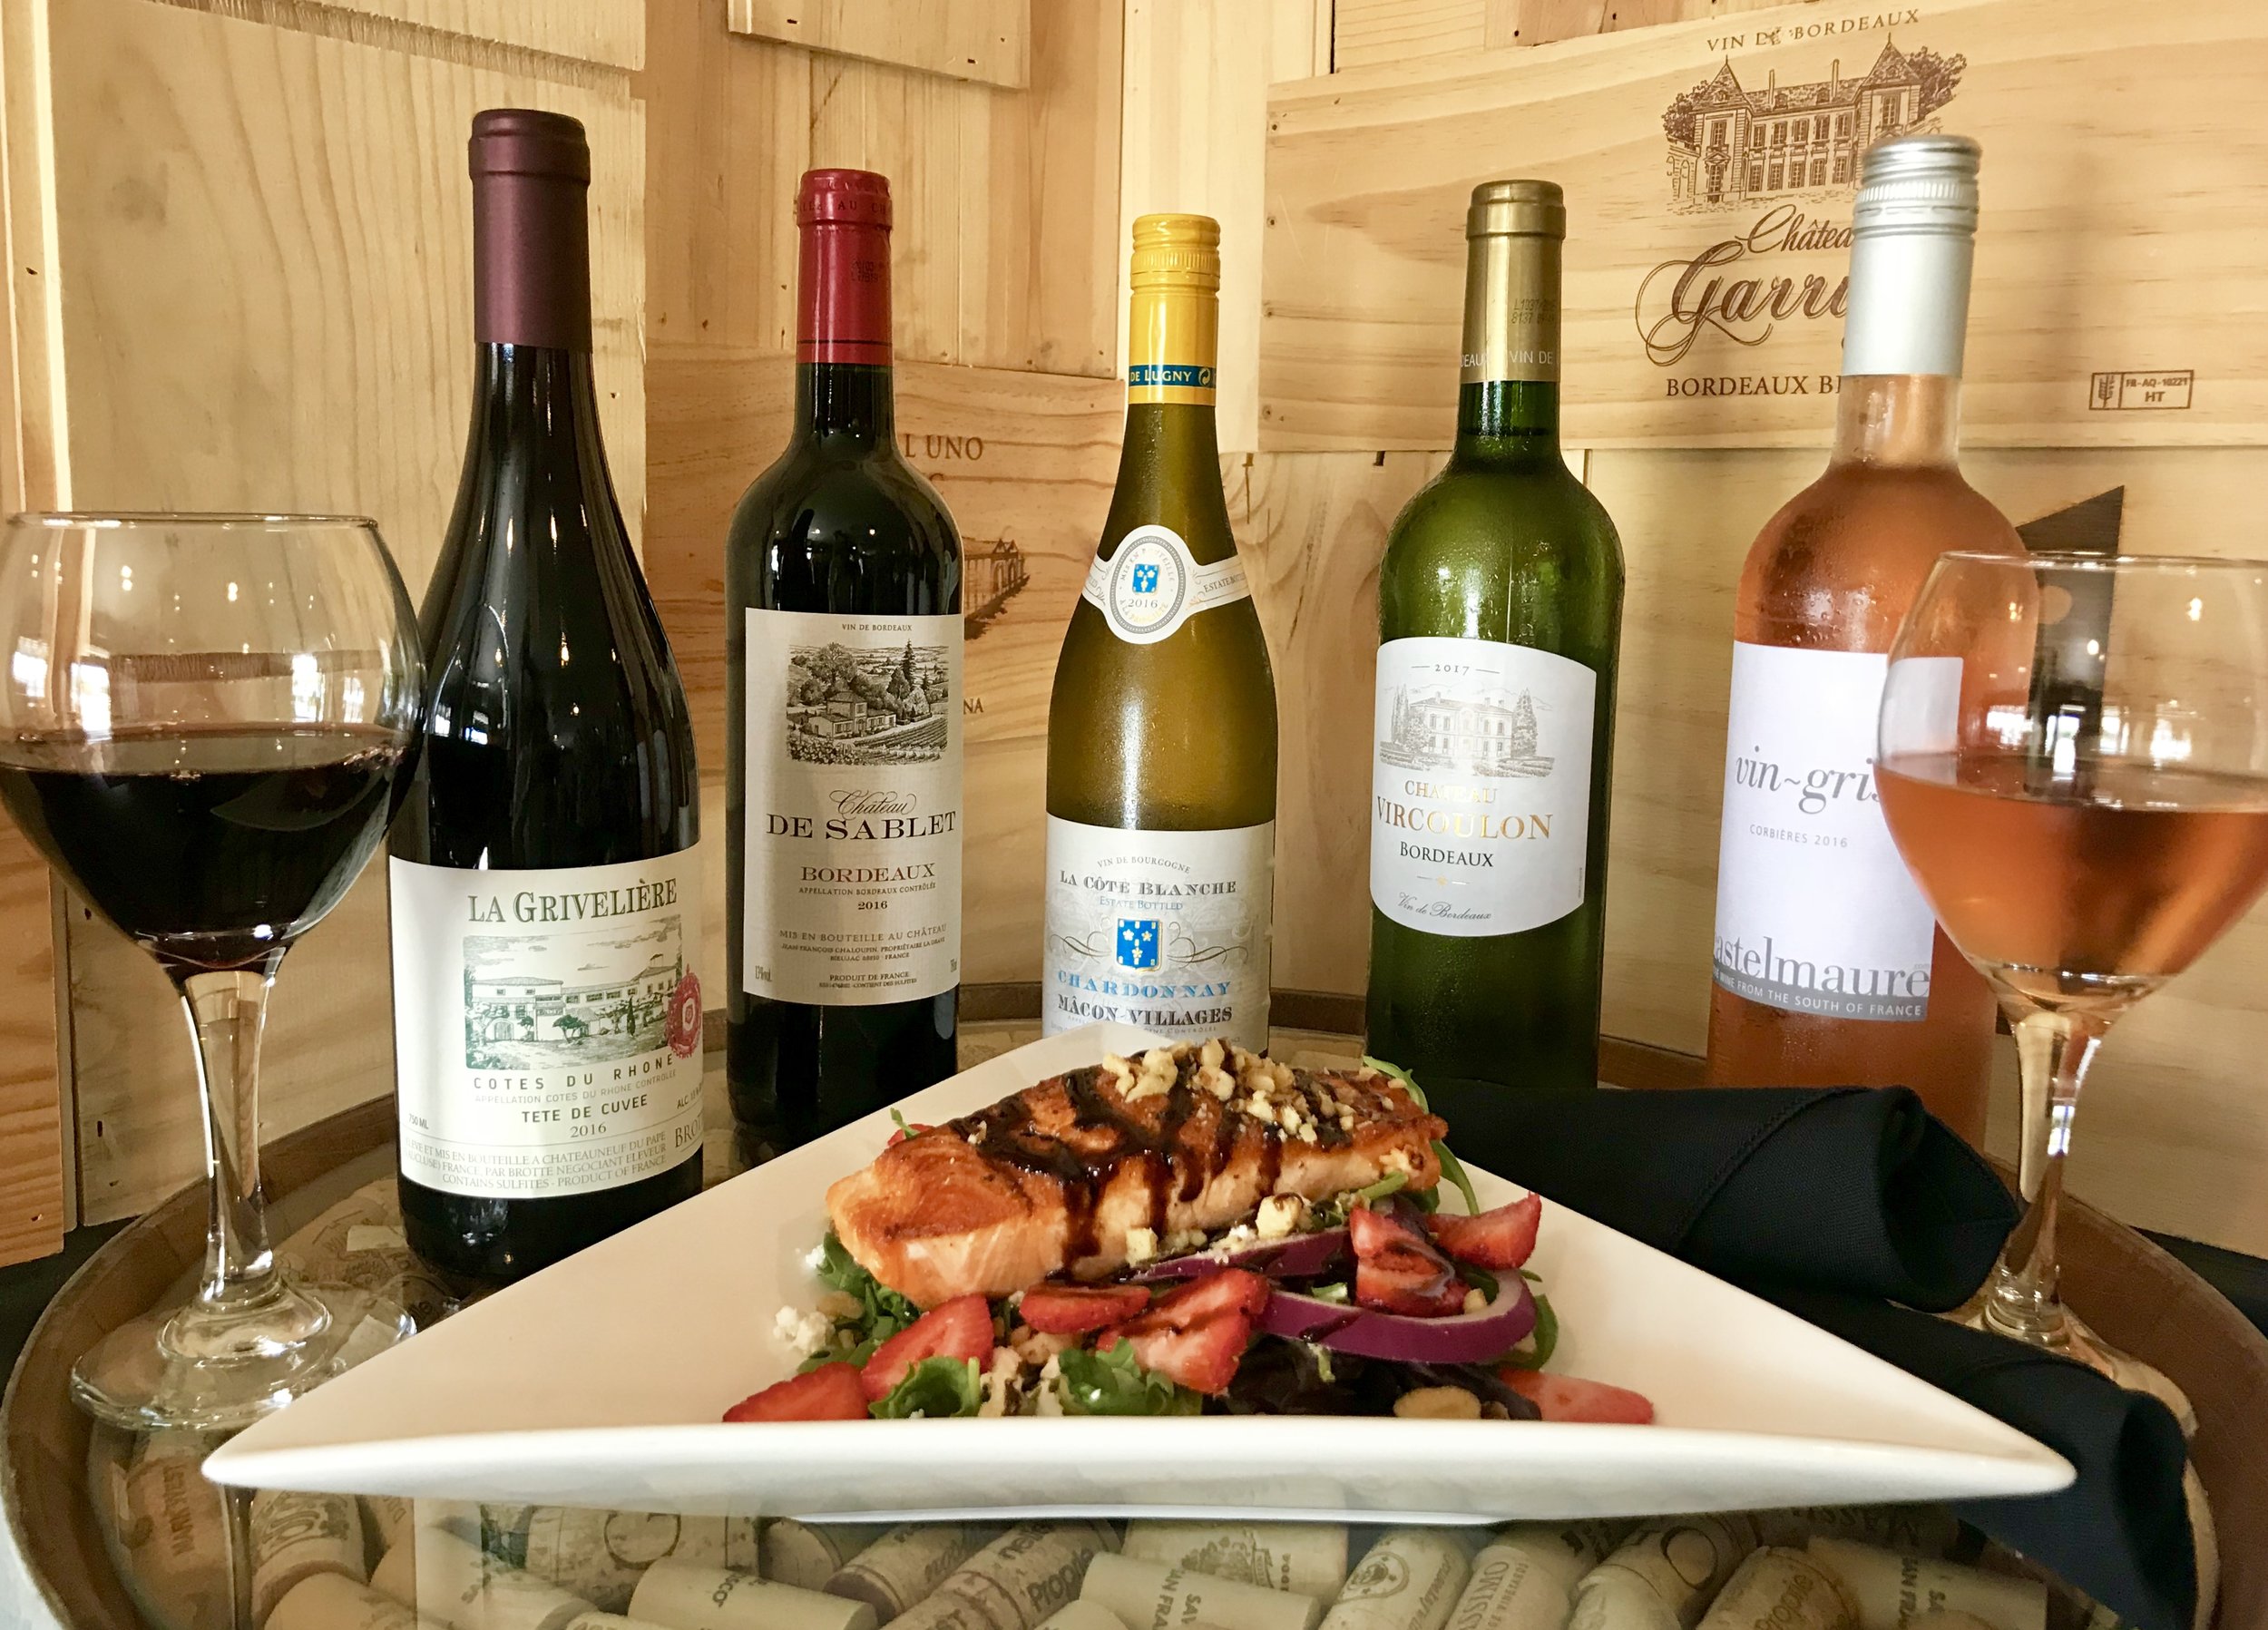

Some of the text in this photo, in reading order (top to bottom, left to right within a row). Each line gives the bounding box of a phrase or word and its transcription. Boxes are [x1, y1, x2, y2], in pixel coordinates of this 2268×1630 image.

[1706, 34, 1745, 52] VIN
[1793, 9, 1920, 40] BORDEAUX
[1735, 204, 1853, 253] Châtea
[1509, 350, 1534, 364] VIN
[1539, 350, 1554, 365] DE
[1130, 370, 1192, 382] DE LUGNY
[1666, 376, 1809, 397] BORDEAUX
[2145, 391, 2166, 402] HT
[925, 434, 982, 461] UNO
[1128, 598, 1158, 609] 2016
[1434, 663, 1471, 676] 2017
[828, 789, 917, 821] Château
[1376, 795, 1553, 840] VIRCOULON
[767, 810, 956, 840] DE SABLET
[1749, 824, 1849, 848] CORBIÈRES 2016
[1097, 855, 1191, 874] VIN DE BOURGOGNE
[1400, 840, 1494, 868] BORDEAUX
[800, 863, 936, 883] BORDEAUX
[1060, 870, 1237, 896] LA CÔTE BLANCHE
[467, 878, 678, 923] LA GRIVELIÈRE
[798, 886, 854, 896] APPELLATION
[855, 886, 897, 895] BORDEAUX
[857, 900, 888, 911] 2016
[1398, 891, 1492, 920] Vin de Bordeaux
[780, 923, 946, 942] MIS EN BOUTEILLE AU CHÂTEAU
[829, 973, 865, 981] PRODUIT
[880, 971, 910, 980] FRANCE
[1716, 935, 1930, 998] astelmaure
[1058, 971, 1231, 999] CHARDONNAY
[1737, 980, 1764, 997] FROM
[1768, 990, 1789, 1003] THE
[1794, 995, 1839, 1011] SOUTH
[1845, 1001, 1863, 1013] OF
[1869, 1003, 1921, 1016] FRANCE
[474, 1053, 673, 1090] COTES DU RHONE
[475, 1095, 542, 1104] APPELLATION
[545, 1092, 578, 1103] COTES
[582, 1090, 597, 1100] DU
[601, 1083, 632, 1097] RHONE
[522, 1094, 648, 1123] TETE DE CUVEE
[419, 1117, 429, 1129] ML
[571, 1123, 607, 1138] 2016
[435, 1147, 450, 1161] MIS
[452, 1151, 465, 1162] EN
[468, 1153, 532, 1166] BOUTEILLE
[543, 1143, 627, 1166] CHATEAUNEUF
[630, 1138, 644, 1151] DU
[646, 1131, 666, 1147] PAPE
[485, 1166, 505, 1176] PAR
[508, 1165, 554, 1177] BROTTE
[556, 1156, 622, 1176] NEGOCIANT
[626, 1143, 667, 1163] ELEVEUR
[443, 1154, 666, 1189] CONTAINS SULFITES PRODUCT OF FRANCE
